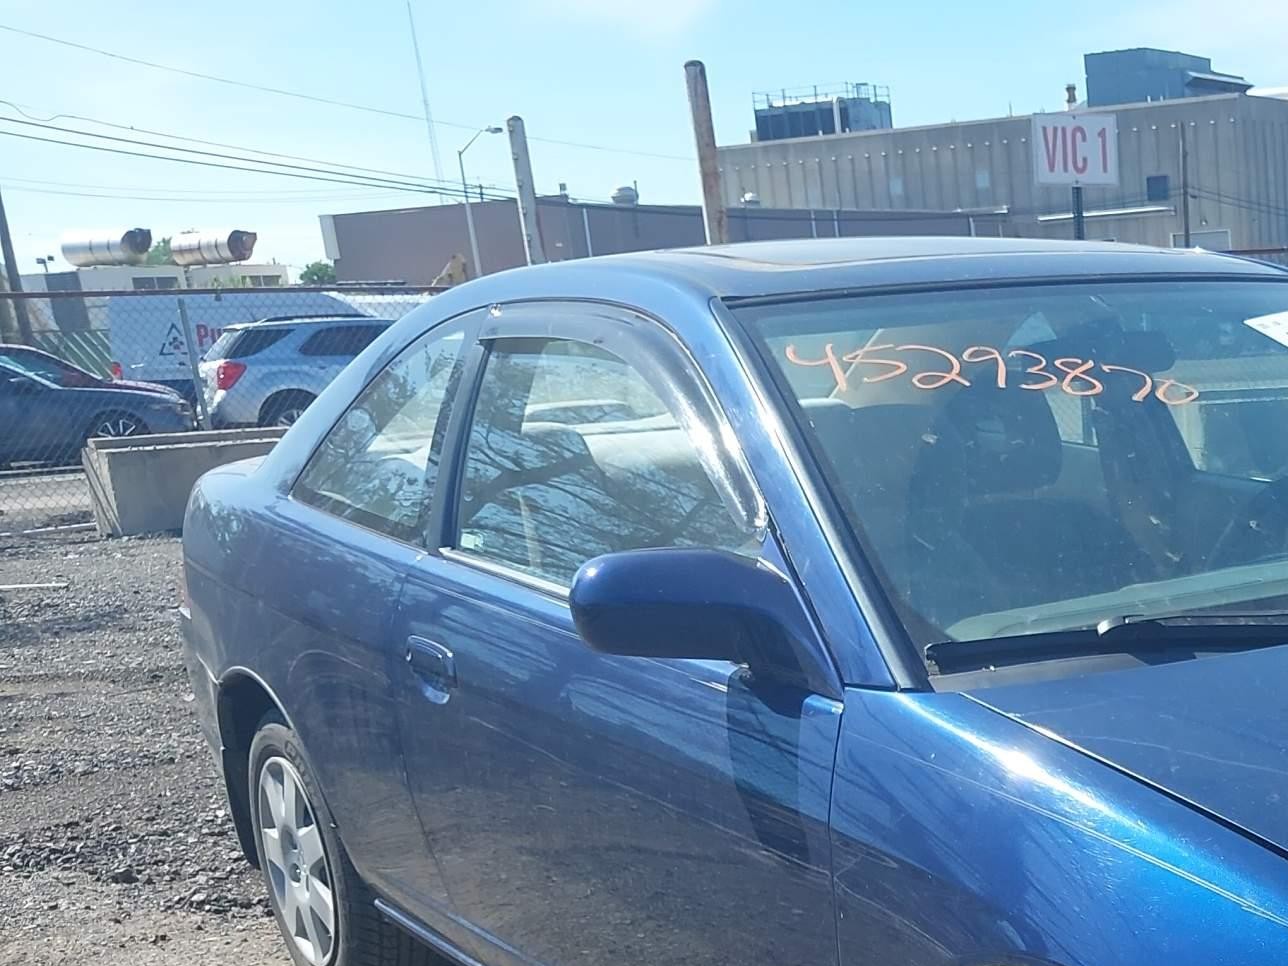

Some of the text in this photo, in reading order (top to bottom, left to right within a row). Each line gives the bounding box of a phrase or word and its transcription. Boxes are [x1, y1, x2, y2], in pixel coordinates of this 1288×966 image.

[1041, 126, 1108, 175] VIC 1
[785, 343, 1200, 405] 45293870
